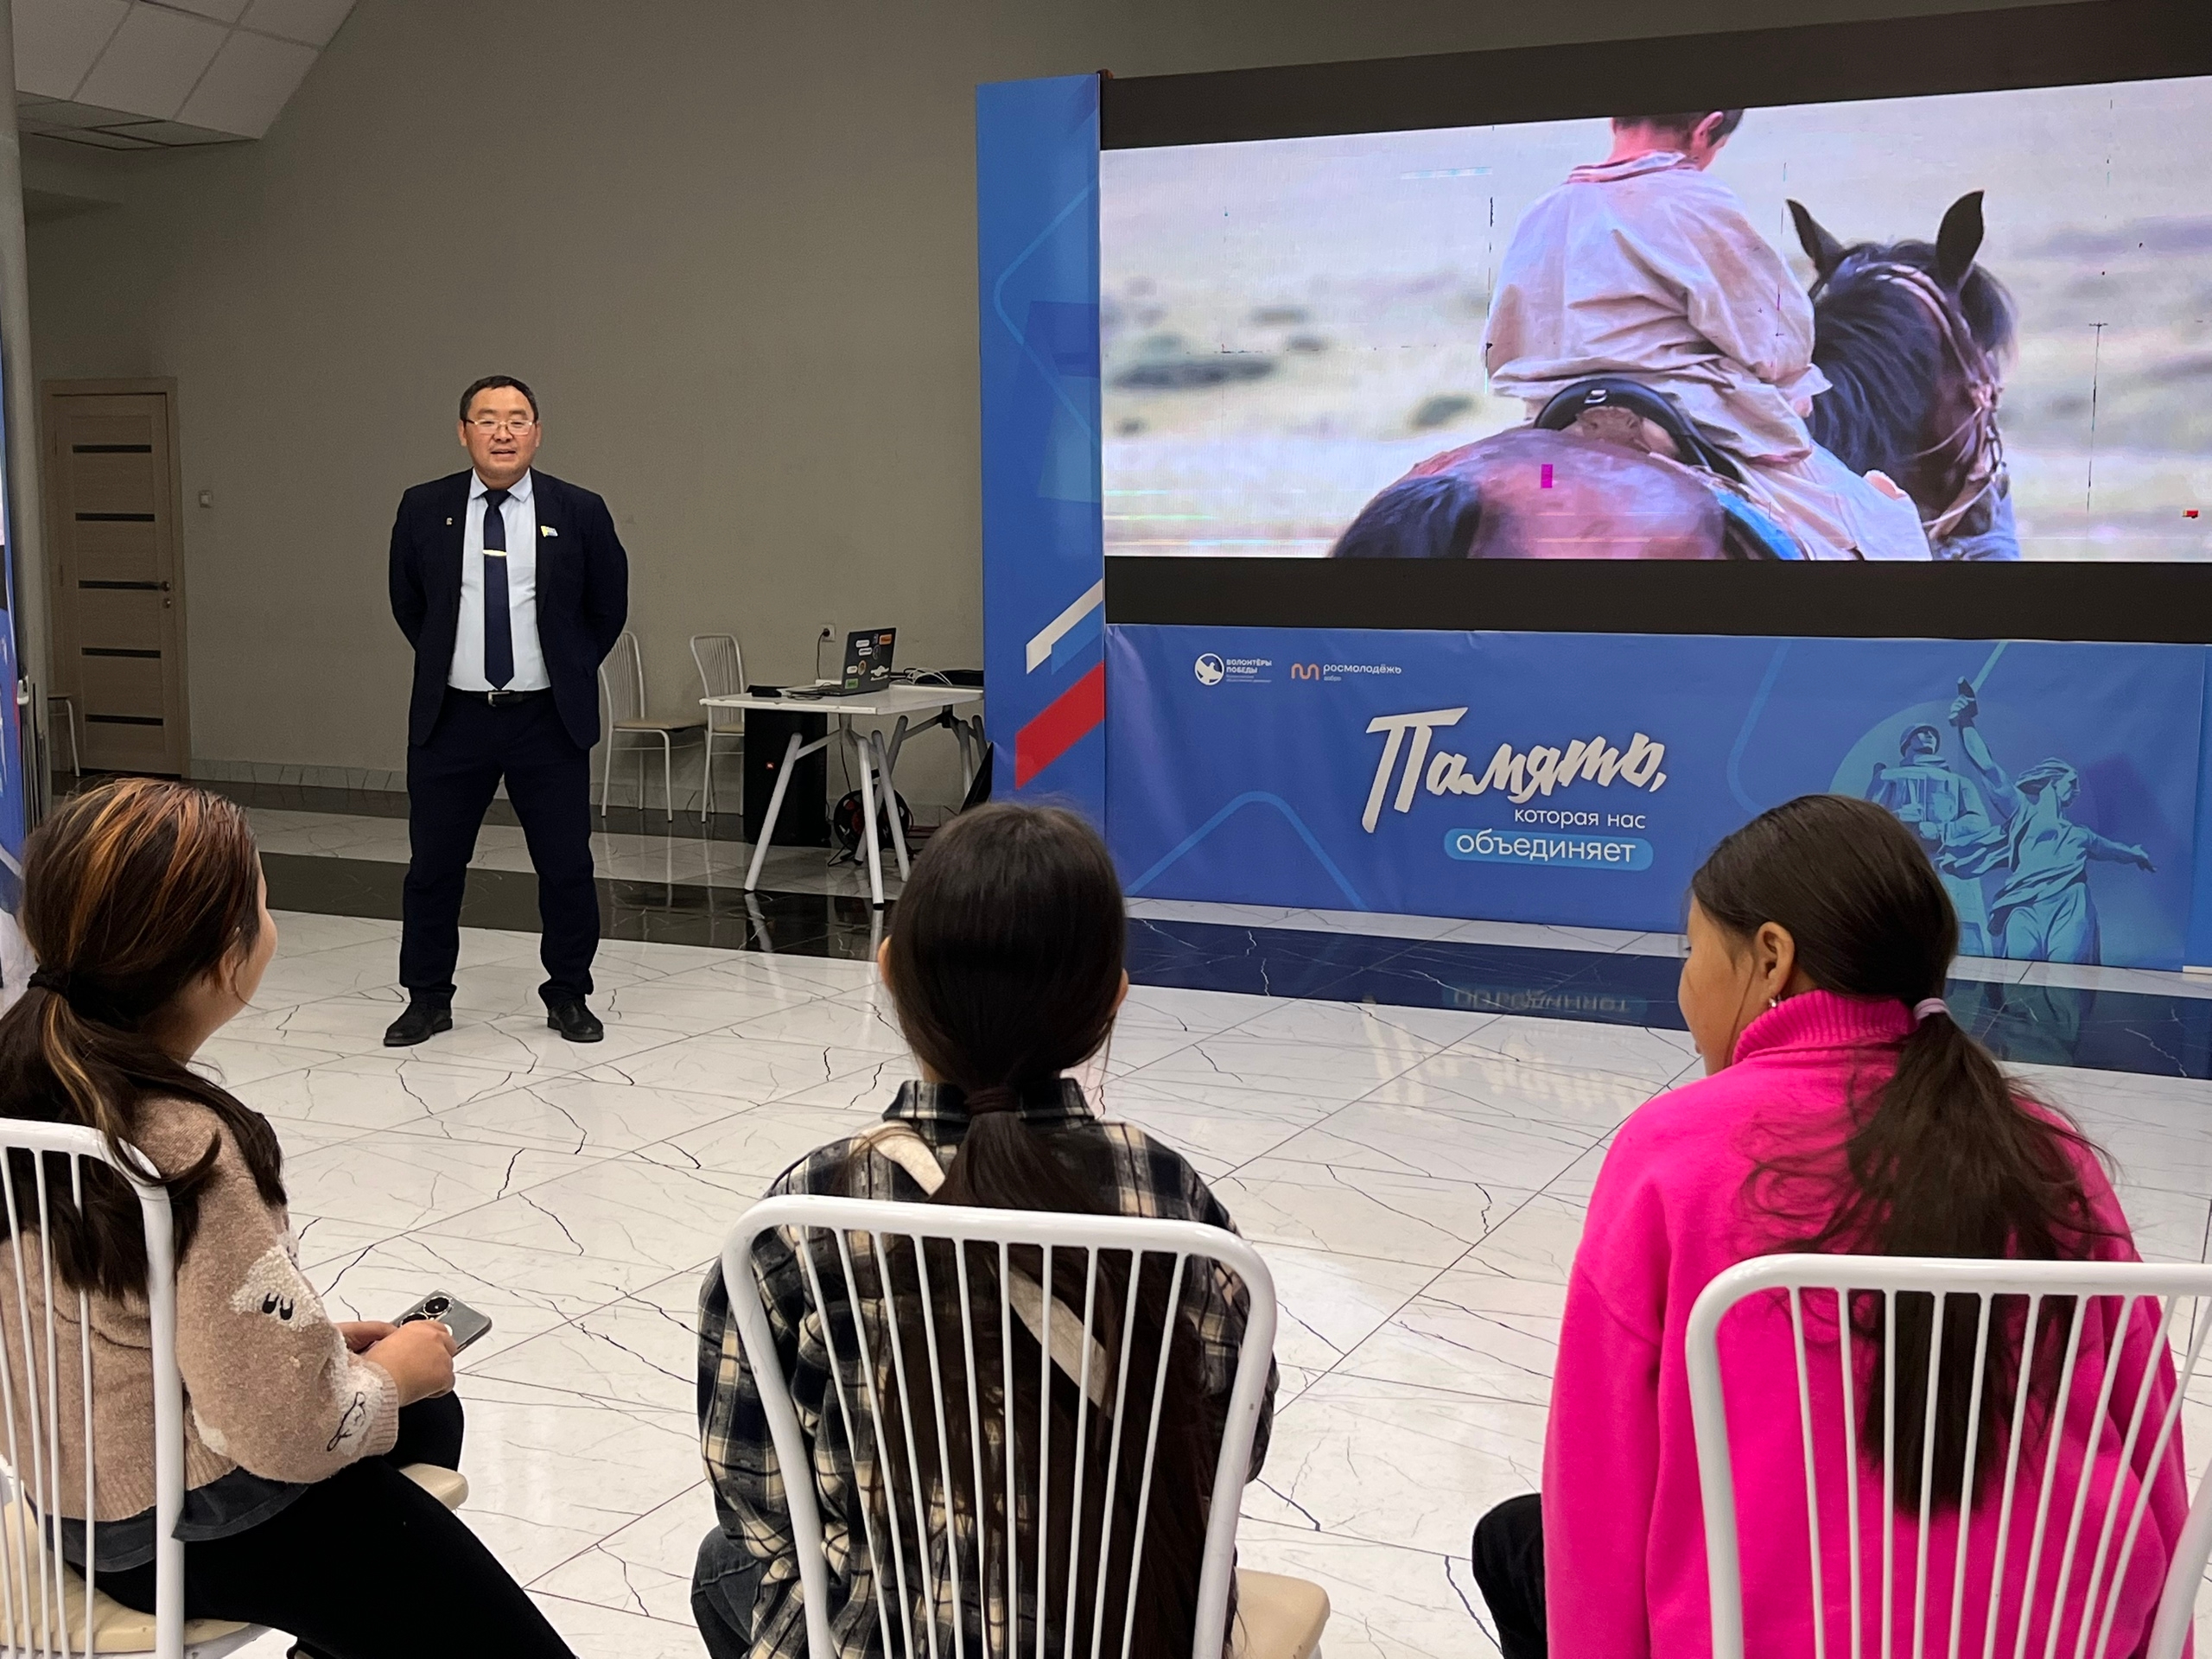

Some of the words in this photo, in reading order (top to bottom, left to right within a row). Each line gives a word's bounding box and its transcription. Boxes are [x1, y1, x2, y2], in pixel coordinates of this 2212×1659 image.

[1323, 664, 1402, 675] росмолодёжь
[1362, 707, 1667, 833] Память,
[1515, 809, 1599, 829] которая
[1607, 814, 1646, 829] нас
[1456, 828, 1636, 862] объединяет
